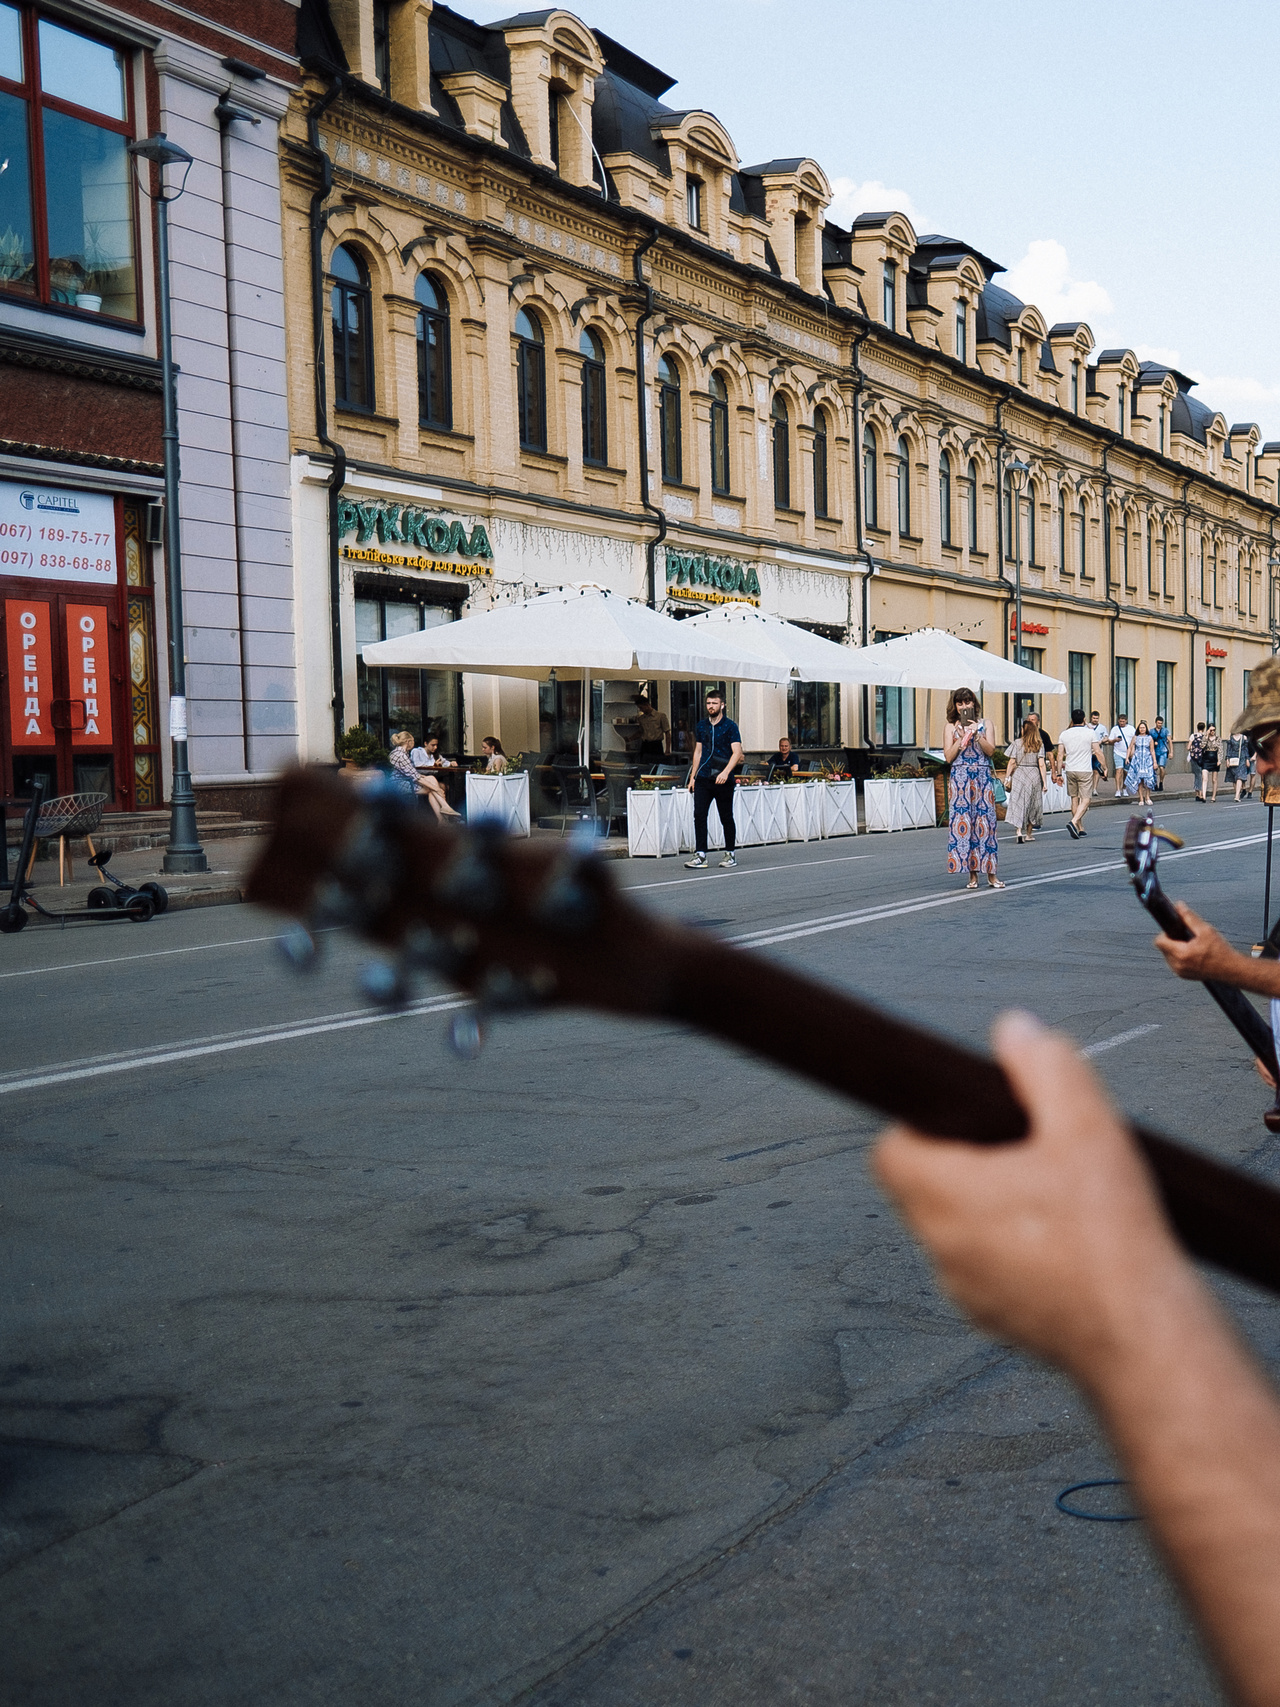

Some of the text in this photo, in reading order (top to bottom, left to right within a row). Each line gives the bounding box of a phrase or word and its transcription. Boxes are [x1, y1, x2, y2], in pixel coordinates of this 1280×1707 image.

[37, 494, 79, 509] CAPITEL
[39, 527, 111, 546] 189-75-77
[337, 500, 494, 559] РУККОЛА
[40, 553, 112, 572] 838-68-88
[406, 555, 433, 571] кафе
[434, 560, 454, 572] для
[455, 562, 486, 577] друзів
[665, 554, 761, 597] РУККОЛА
[20, 612, 42, 735] ОРЕНДА
[80, 616, 100, 735] ОРЕНДА
